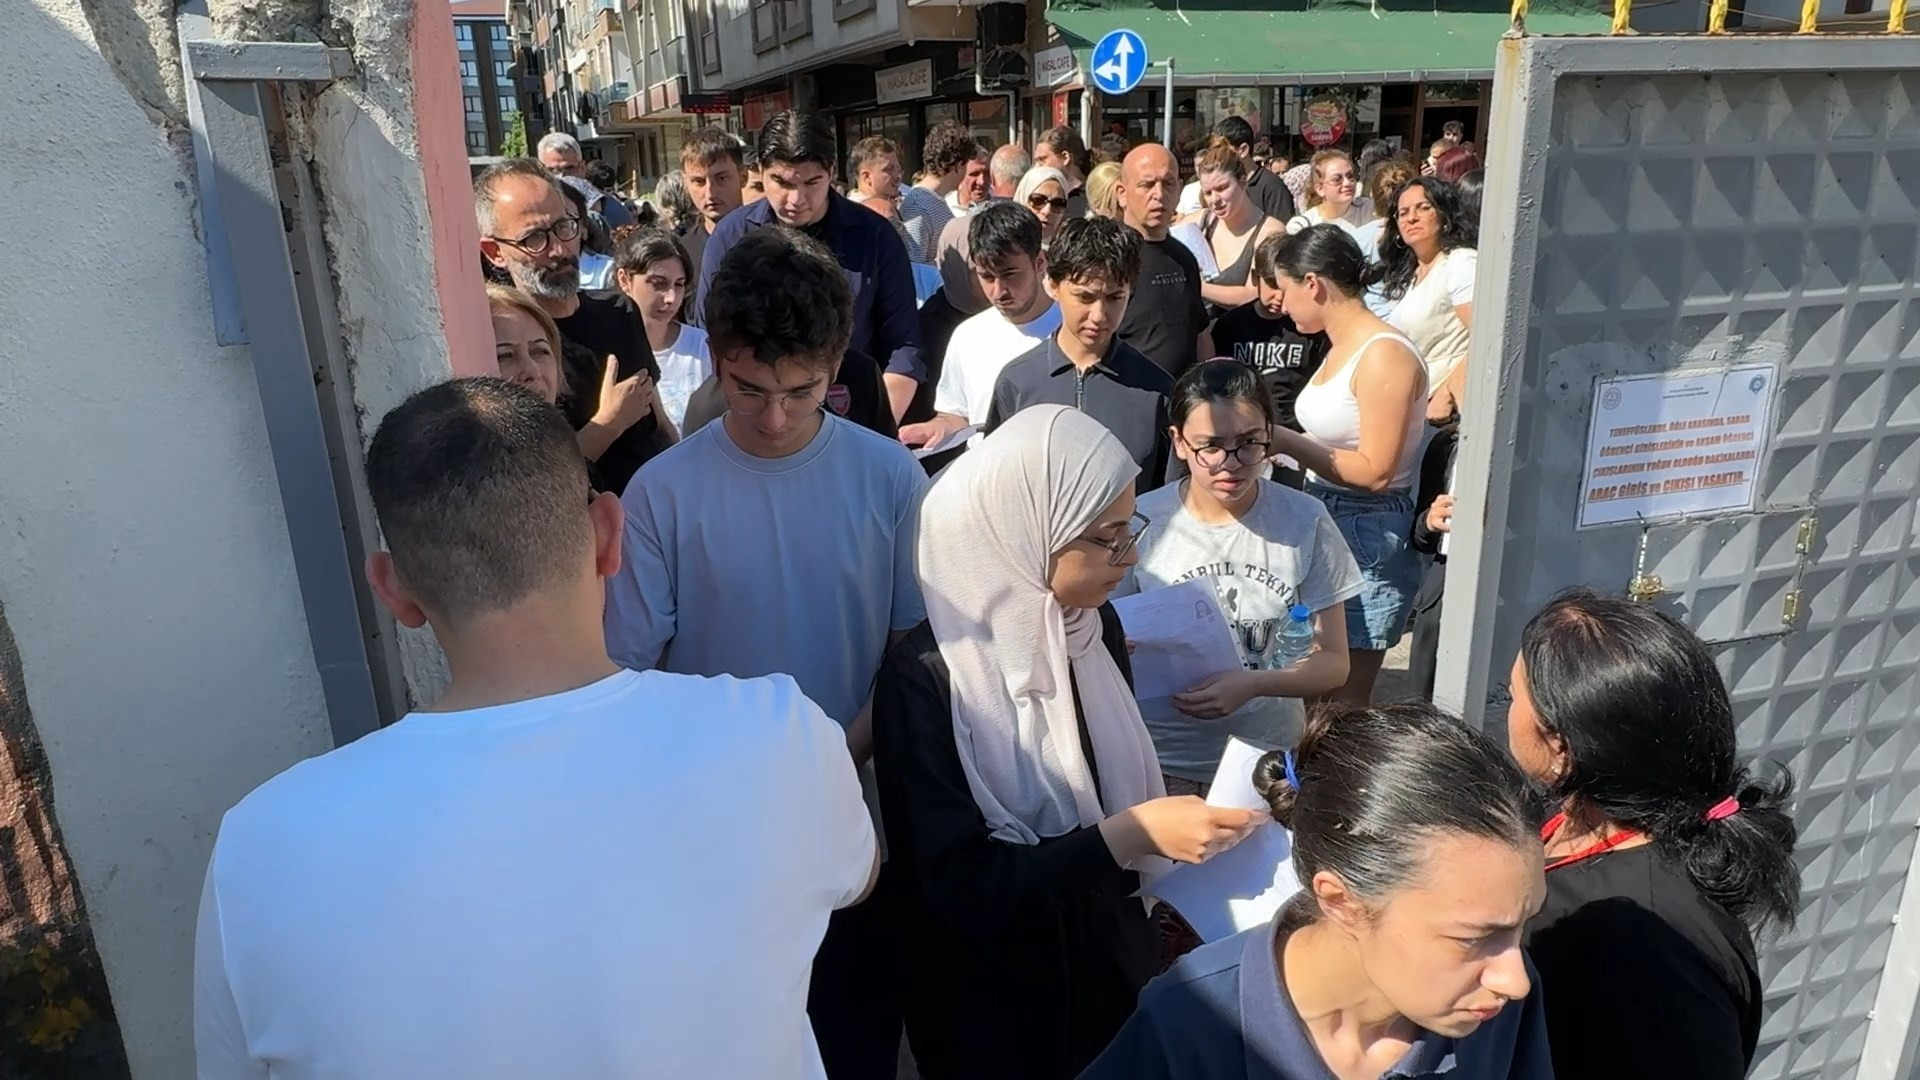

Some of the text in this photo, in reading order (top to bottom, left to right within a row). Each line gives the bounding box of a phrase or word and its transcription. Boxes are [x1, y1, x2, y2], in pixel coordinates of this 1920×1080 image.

[909, 68, 928, 86] CAFE
[1234, 342, 1303, 368] NIKE
[1649, 482, 1661, 494] ve
